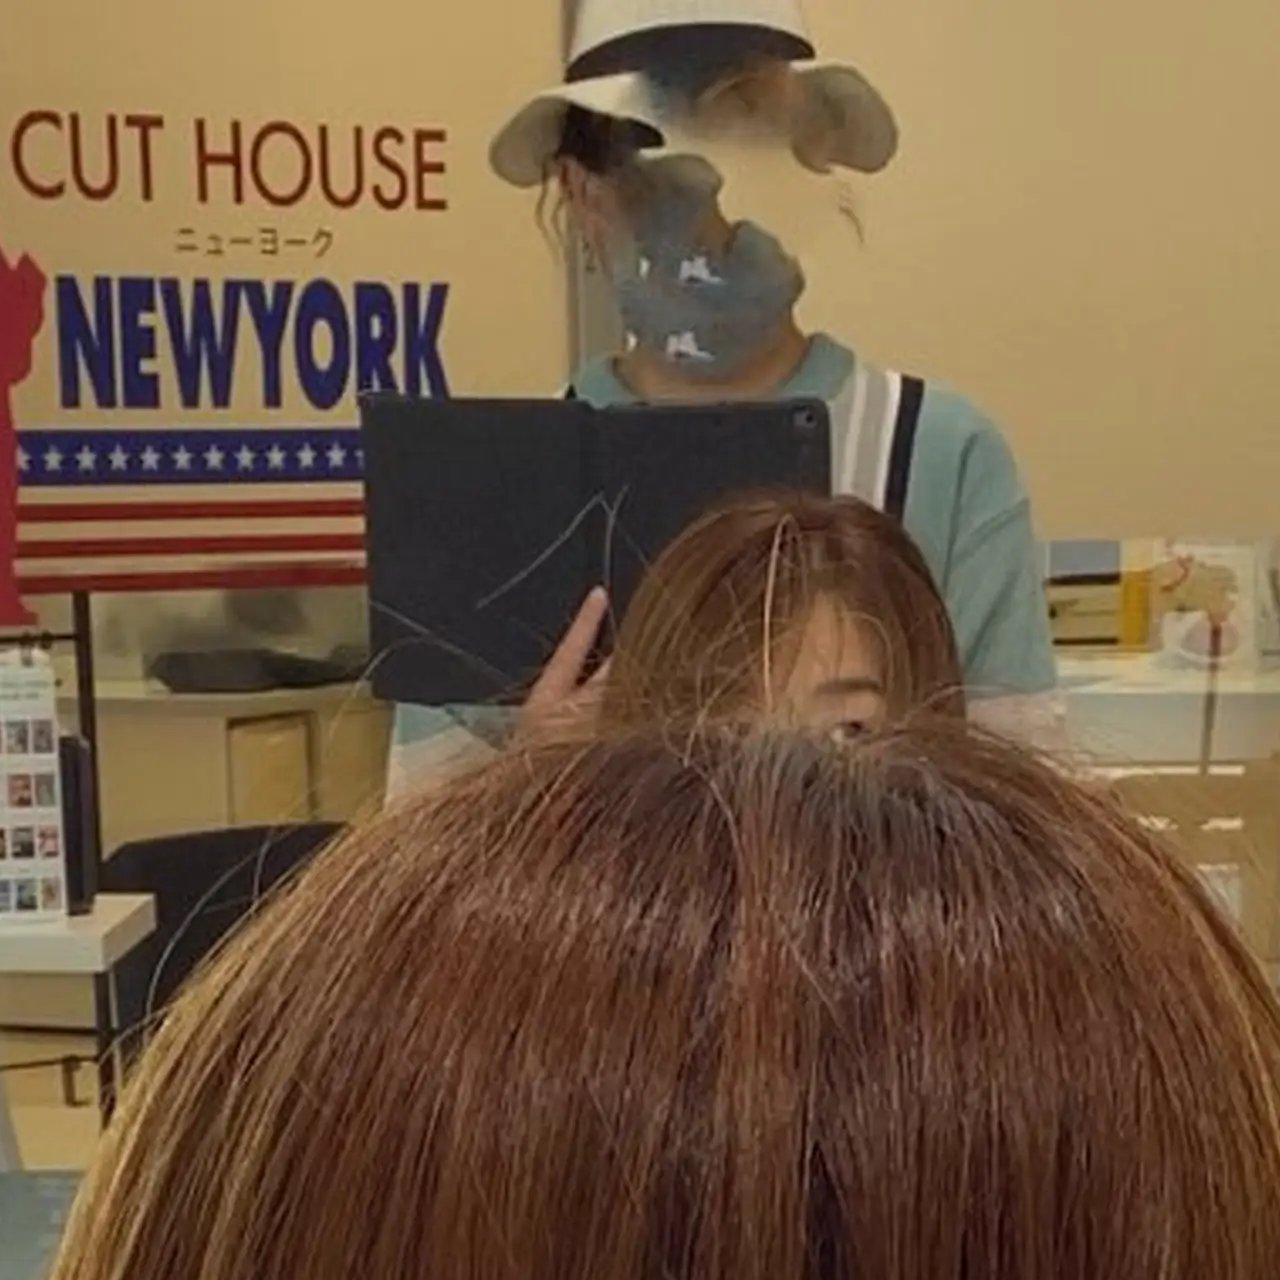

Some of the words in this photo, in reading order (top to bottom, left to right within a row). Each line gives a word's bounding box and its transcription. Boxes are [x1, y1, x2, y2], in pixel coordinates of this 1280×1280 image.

[11, 110, 164, 201] CUT
[195, 118, 448, 211] HOUSE
[174, 227, 333, 259] ニューヨーク
[55, 274, 450, 410] NEWYORK
